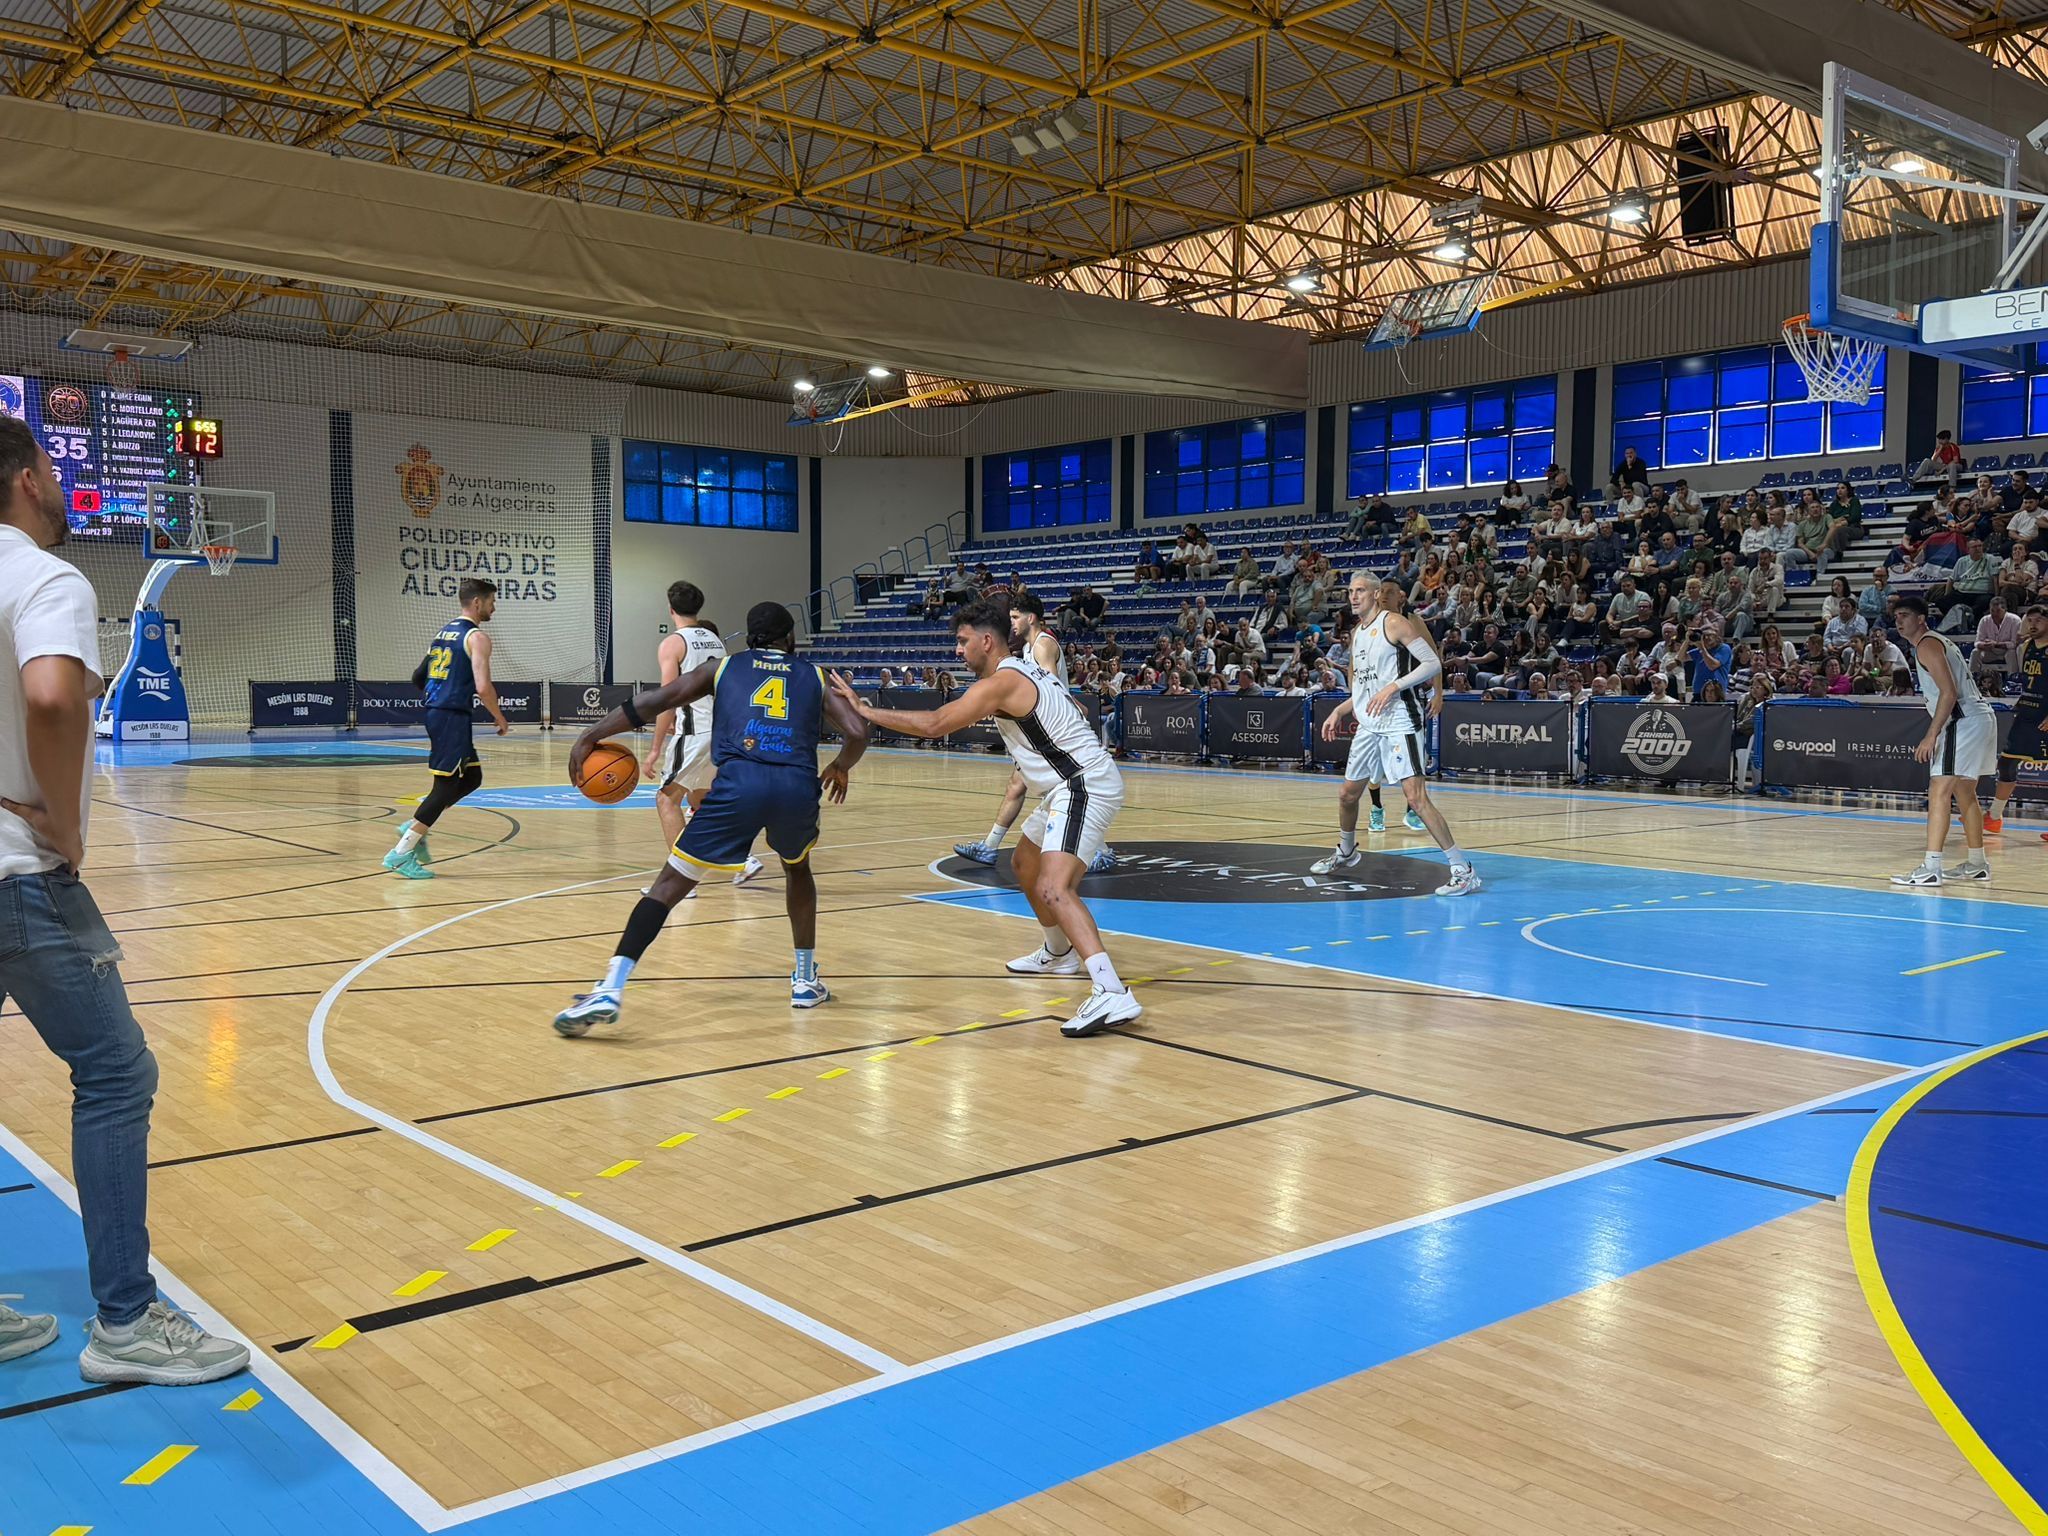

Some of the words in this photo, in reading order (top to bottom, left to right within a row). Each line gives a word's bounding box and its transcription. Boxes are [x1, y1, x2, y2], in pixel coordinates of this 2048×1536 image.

[43, 424, 53, 433] CB
[55, 425, 92, 436] MARBELLA
[47, 436, 88, 460] 35
[195, 434, 217, 454] 12
[102, 477, 111, 486] 10
[448, 473, 556, 495] Ayuntamiento
[102, 490, 111, 498] 13
[80, 494, 93, 509] 4
[102, 502, 110, 511] 21
[447, 493, 467, 507] de
[472, 492, 555, 513] Algeciras
[102, 515, 112, 523] 28
[102, 527, 112, 536] 99
[399, 526, 555, 549] POLIDEPORTIVO
[400, 547, 513, 574] CIUDAD
[521, 553, 556, 576] DE
[401, 573, 556, 600] ALGIRAS
[428, 646, 453, 680] 22
[752, 659, 792, 672] MARK
[137, 678, 170, 690] TME
[2027, 676, 2035, 689] 7
[267, 692, 292, 707] MESÓN
[292, 693, 306, 703] LAS
[307, 693, 334, 706] DUELAS
[363, 698, 392, 708] BODY
[750, 675, 789, 720] 4
[293, 706, 309, 716] 1988
[149, 722, 159, 730] LAS
[1166, 716, 1195, 729] ROA
[1127, 725, 1152, 736] LABOR
[1456, 723, 1552, 742] CENTRAL
[1231, 732, 1280, 744] ASESORES
[1620, 737, 1692, 756] 2000
[1786, 738, 1836, 756] surpool
[1847, 742, 1880, 752] IRENE
[1114, 854, 1390, 892] AWKINS
